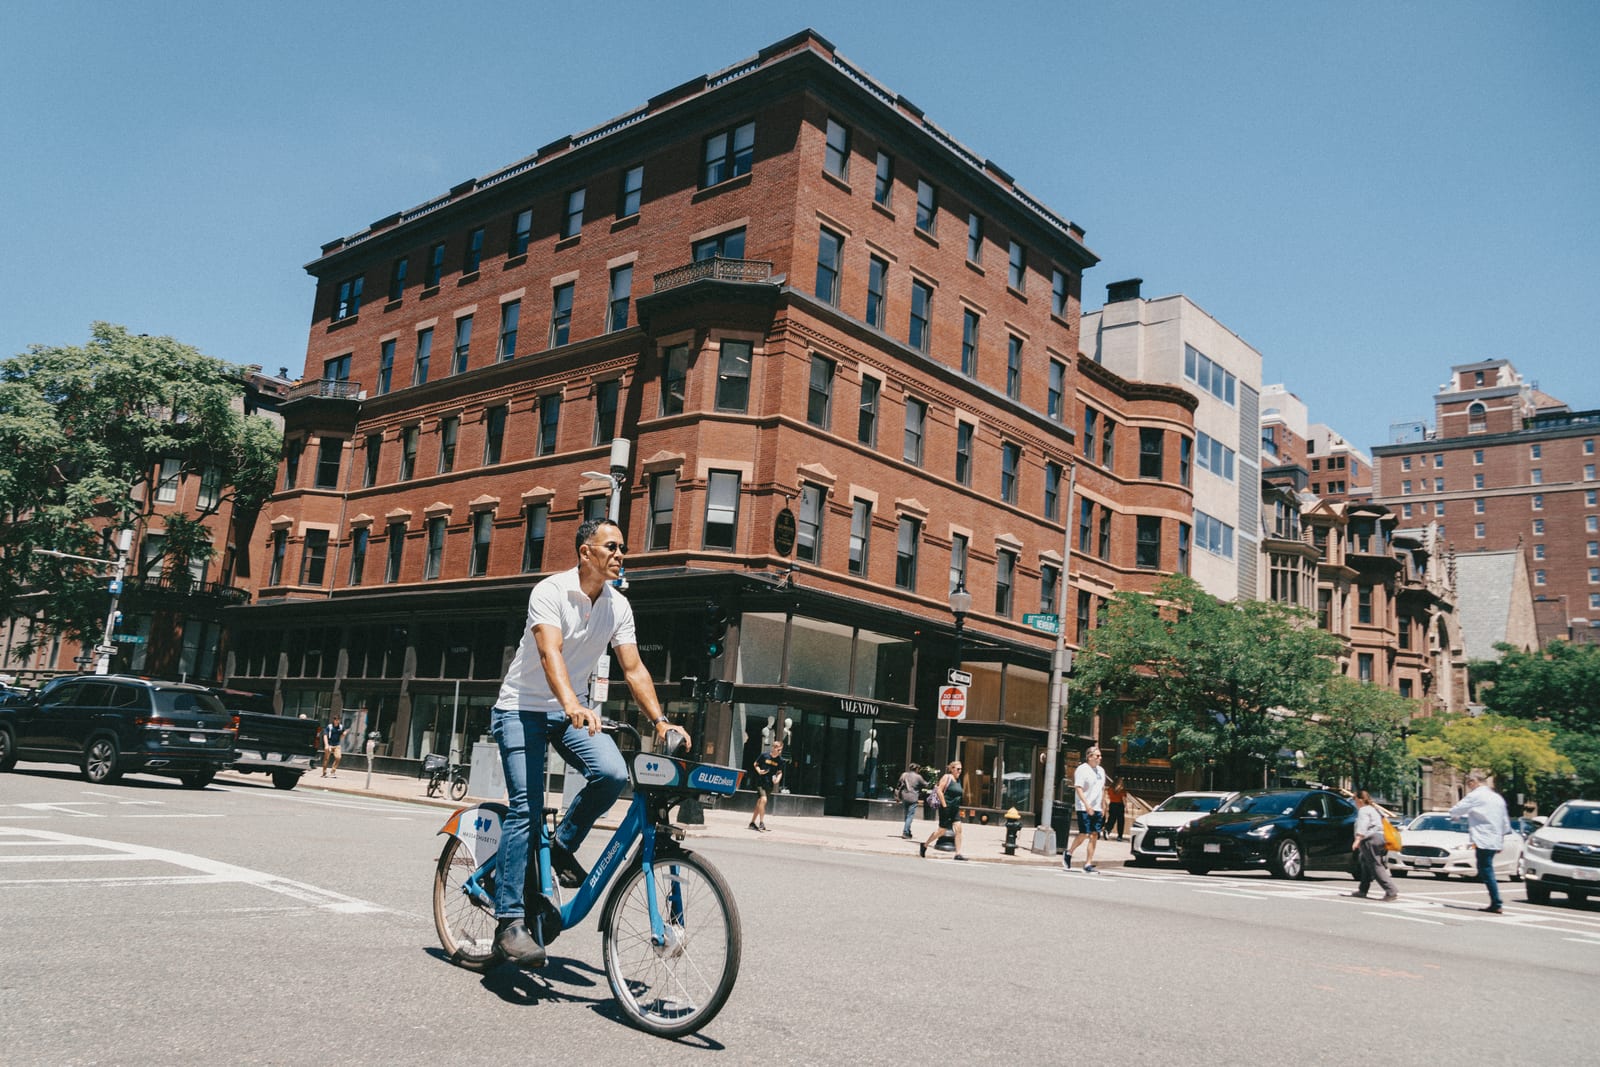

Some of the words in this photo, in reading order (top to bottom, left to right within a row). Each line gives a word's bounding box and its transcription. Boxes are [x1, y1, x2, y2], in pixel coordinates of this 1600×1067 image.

[840, 699, 879, 716] VALENTINO
[698, 772, 733, 787] BLUEbikes
[589, 840, 621, 889] BLUEbikes
